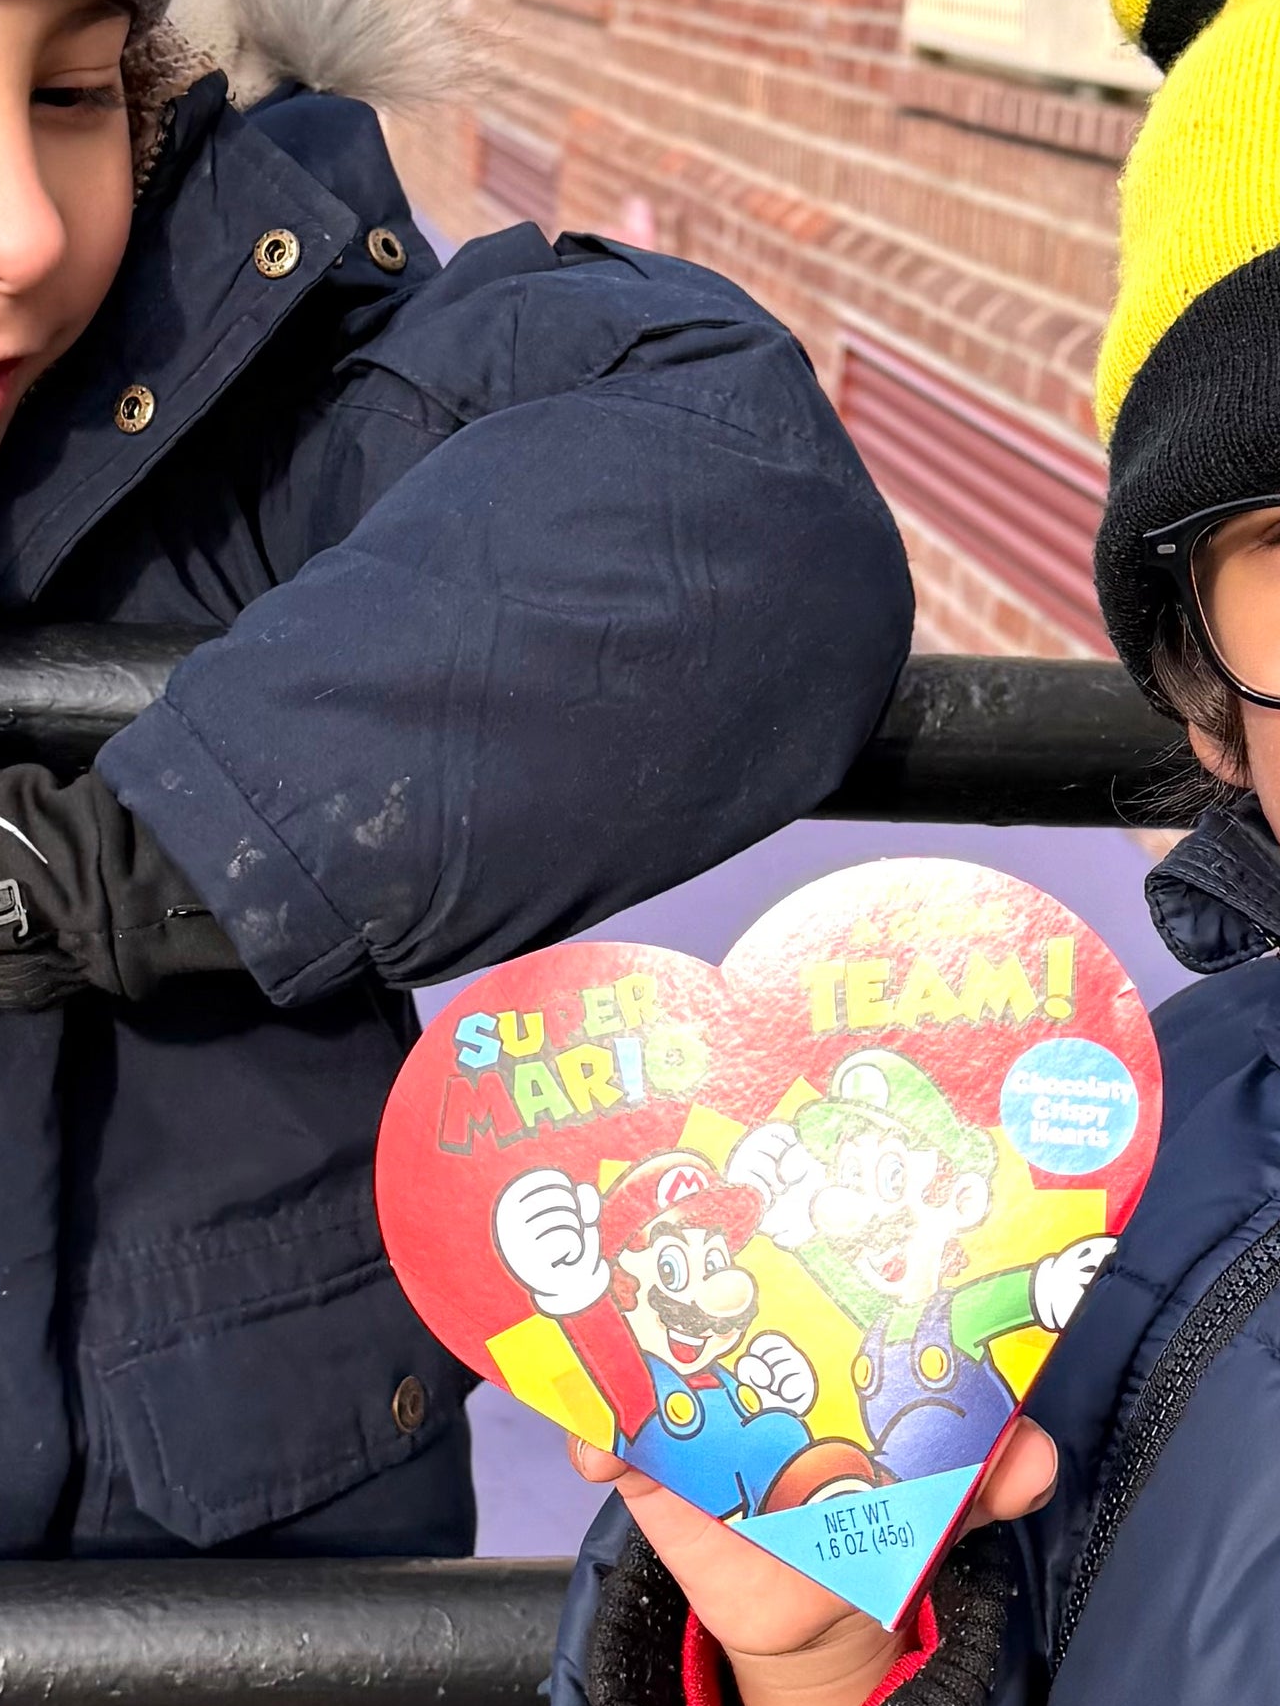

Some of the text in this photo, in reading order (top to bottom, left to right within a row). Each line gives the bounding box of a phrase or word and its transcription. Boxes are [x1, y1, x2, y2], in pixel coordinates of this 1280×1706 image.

[798, 934, 1077, 1033] TEAM!
[453, 971, 660, 1070] SUPER
[439, 1023, 712, 1151] MARIO
[1029, 1119, 1111, 1149] Hearts
[664, 1169, 705, 1203] M
[823, 1499, 891, 1535] NET WT
[814, 1520, 915, 1562] 1.6 OZ (45g)
